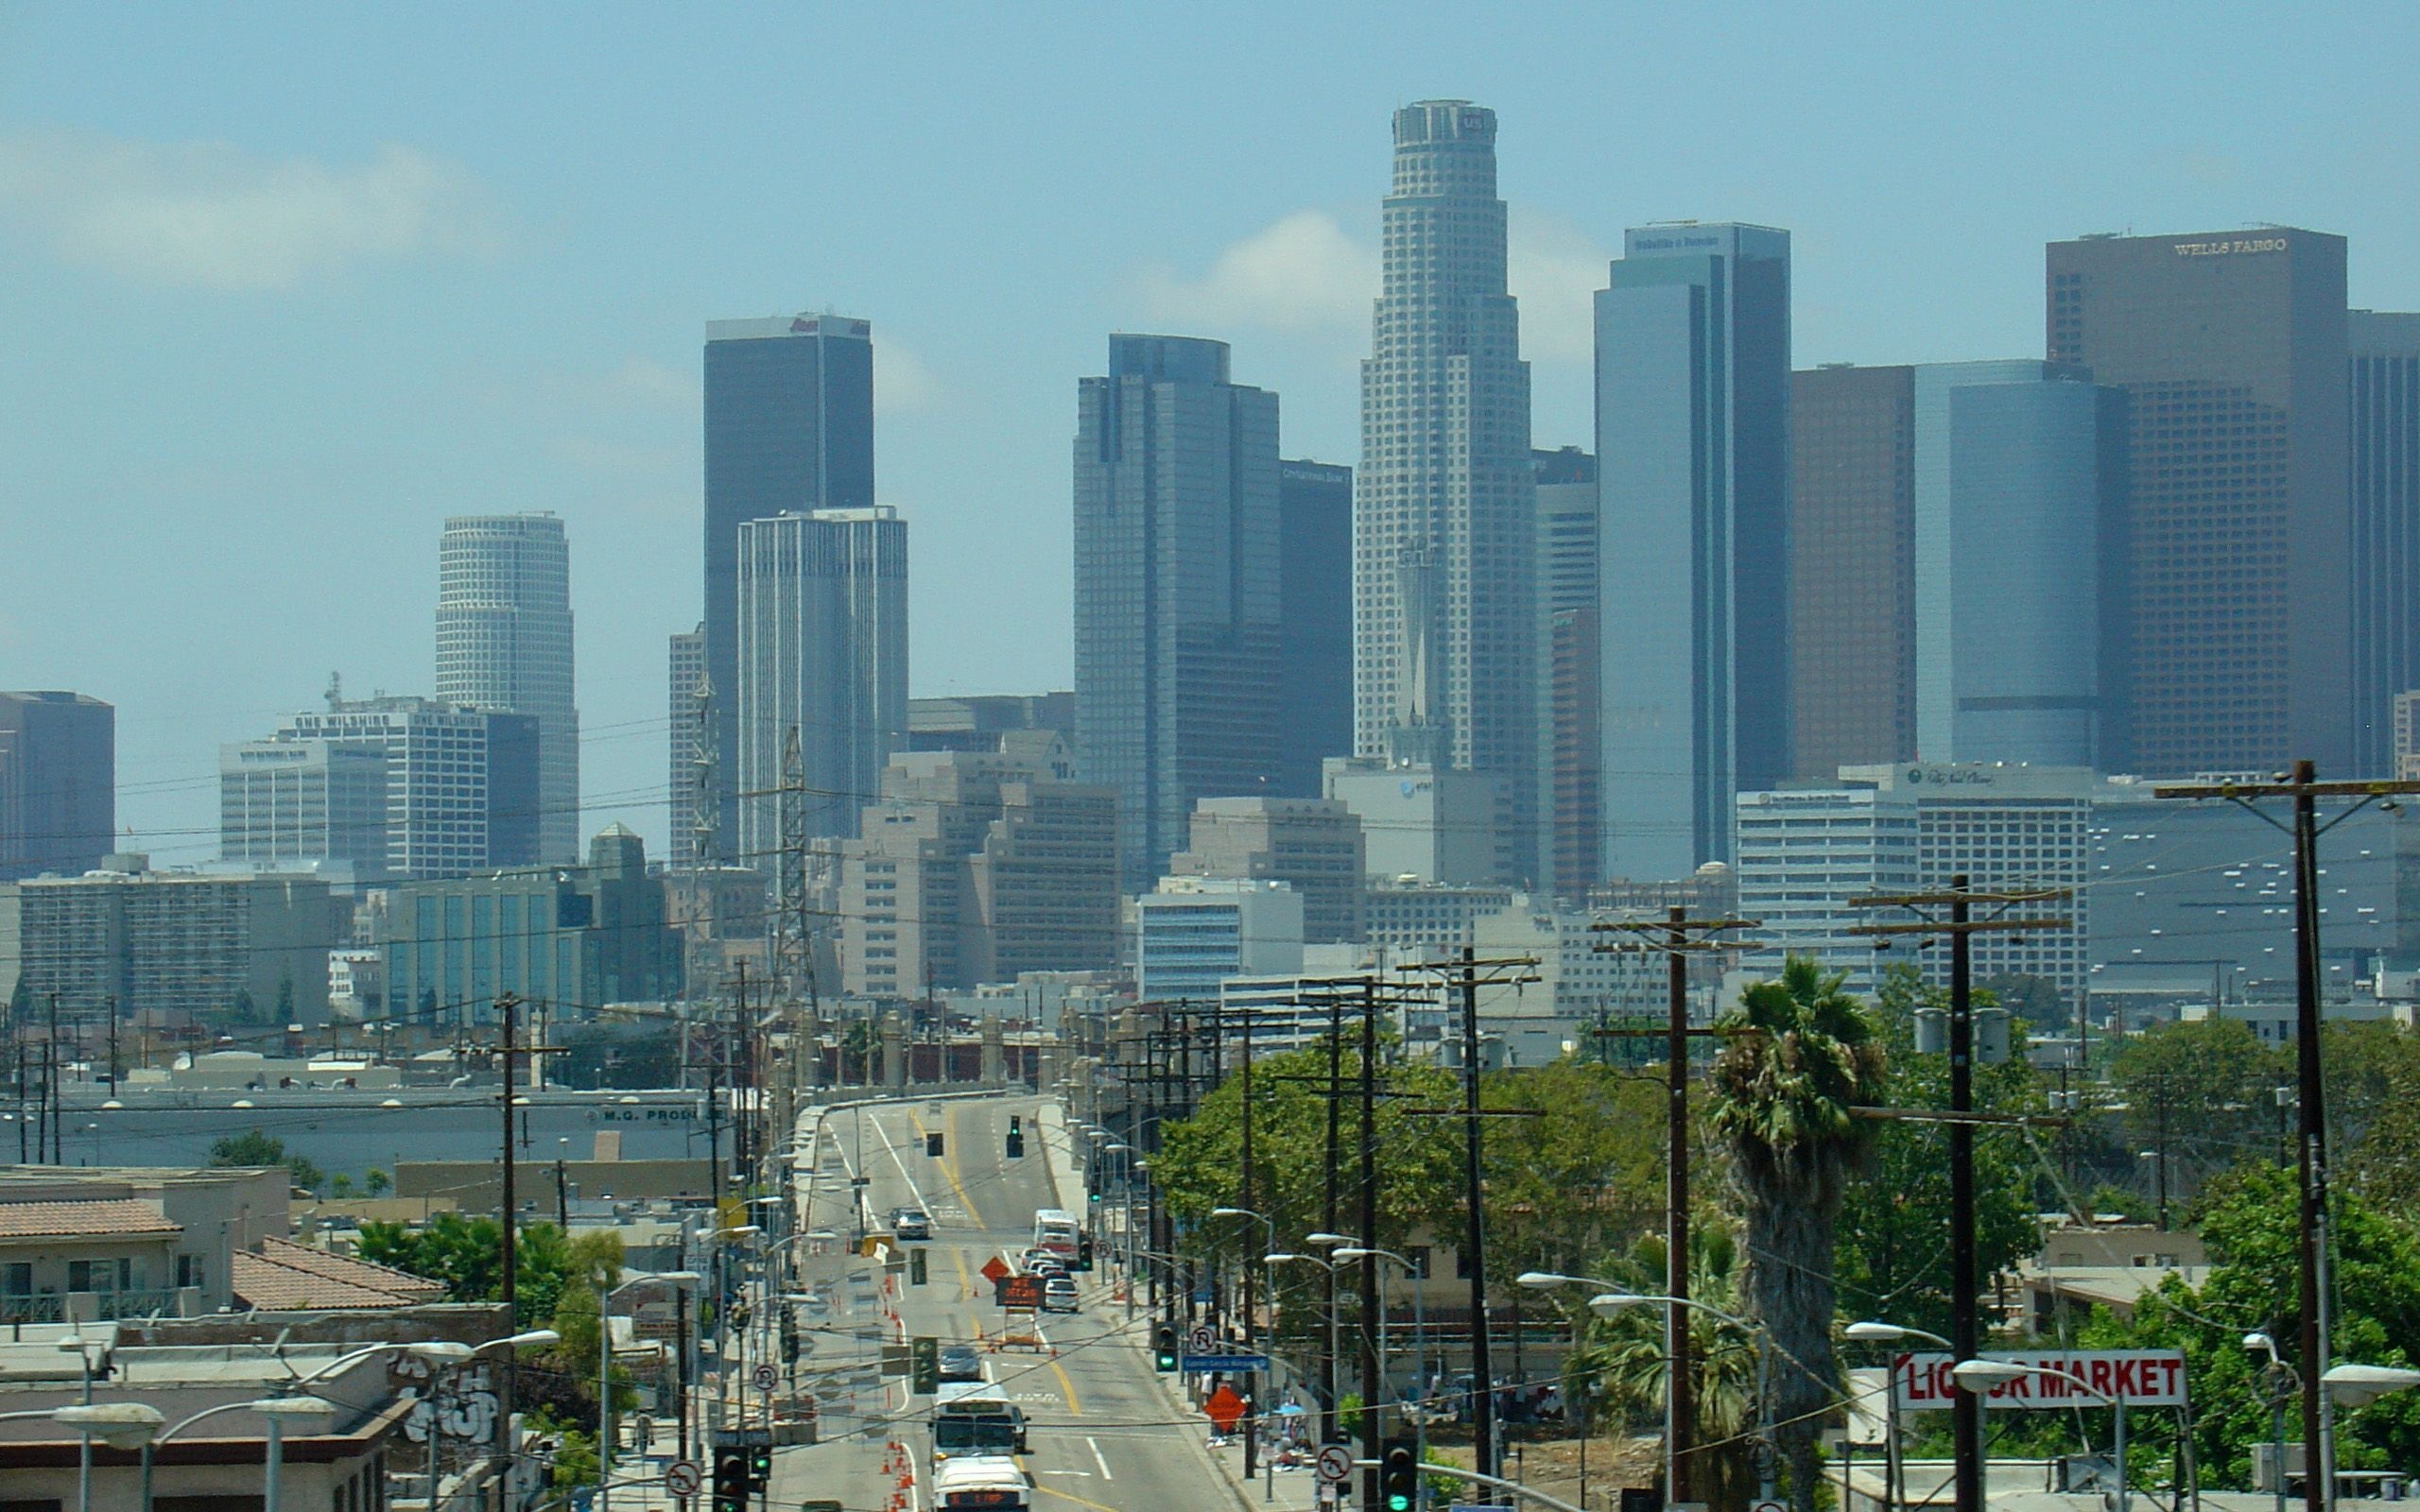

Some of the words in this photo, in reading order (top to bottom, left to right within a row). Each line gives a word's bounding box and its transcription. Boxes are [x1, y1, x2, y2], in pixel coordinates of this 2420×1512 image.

[2174, 242, 2229, 255] WELLS
[2233, 238, 2287, 253] FARGO
[295, 716, 321, 729] ONE
[326, 714, 389, 728] WILSHIRE
[414, 714, 434, 726] ONE
[437, 715, 482, 728] WILSHIRE
[647, 1110, 725, 1121] PRODE
[1909, 1361, 2030, 1400] LIQR
[2038, 1359, 2181, 1398] MARKET
